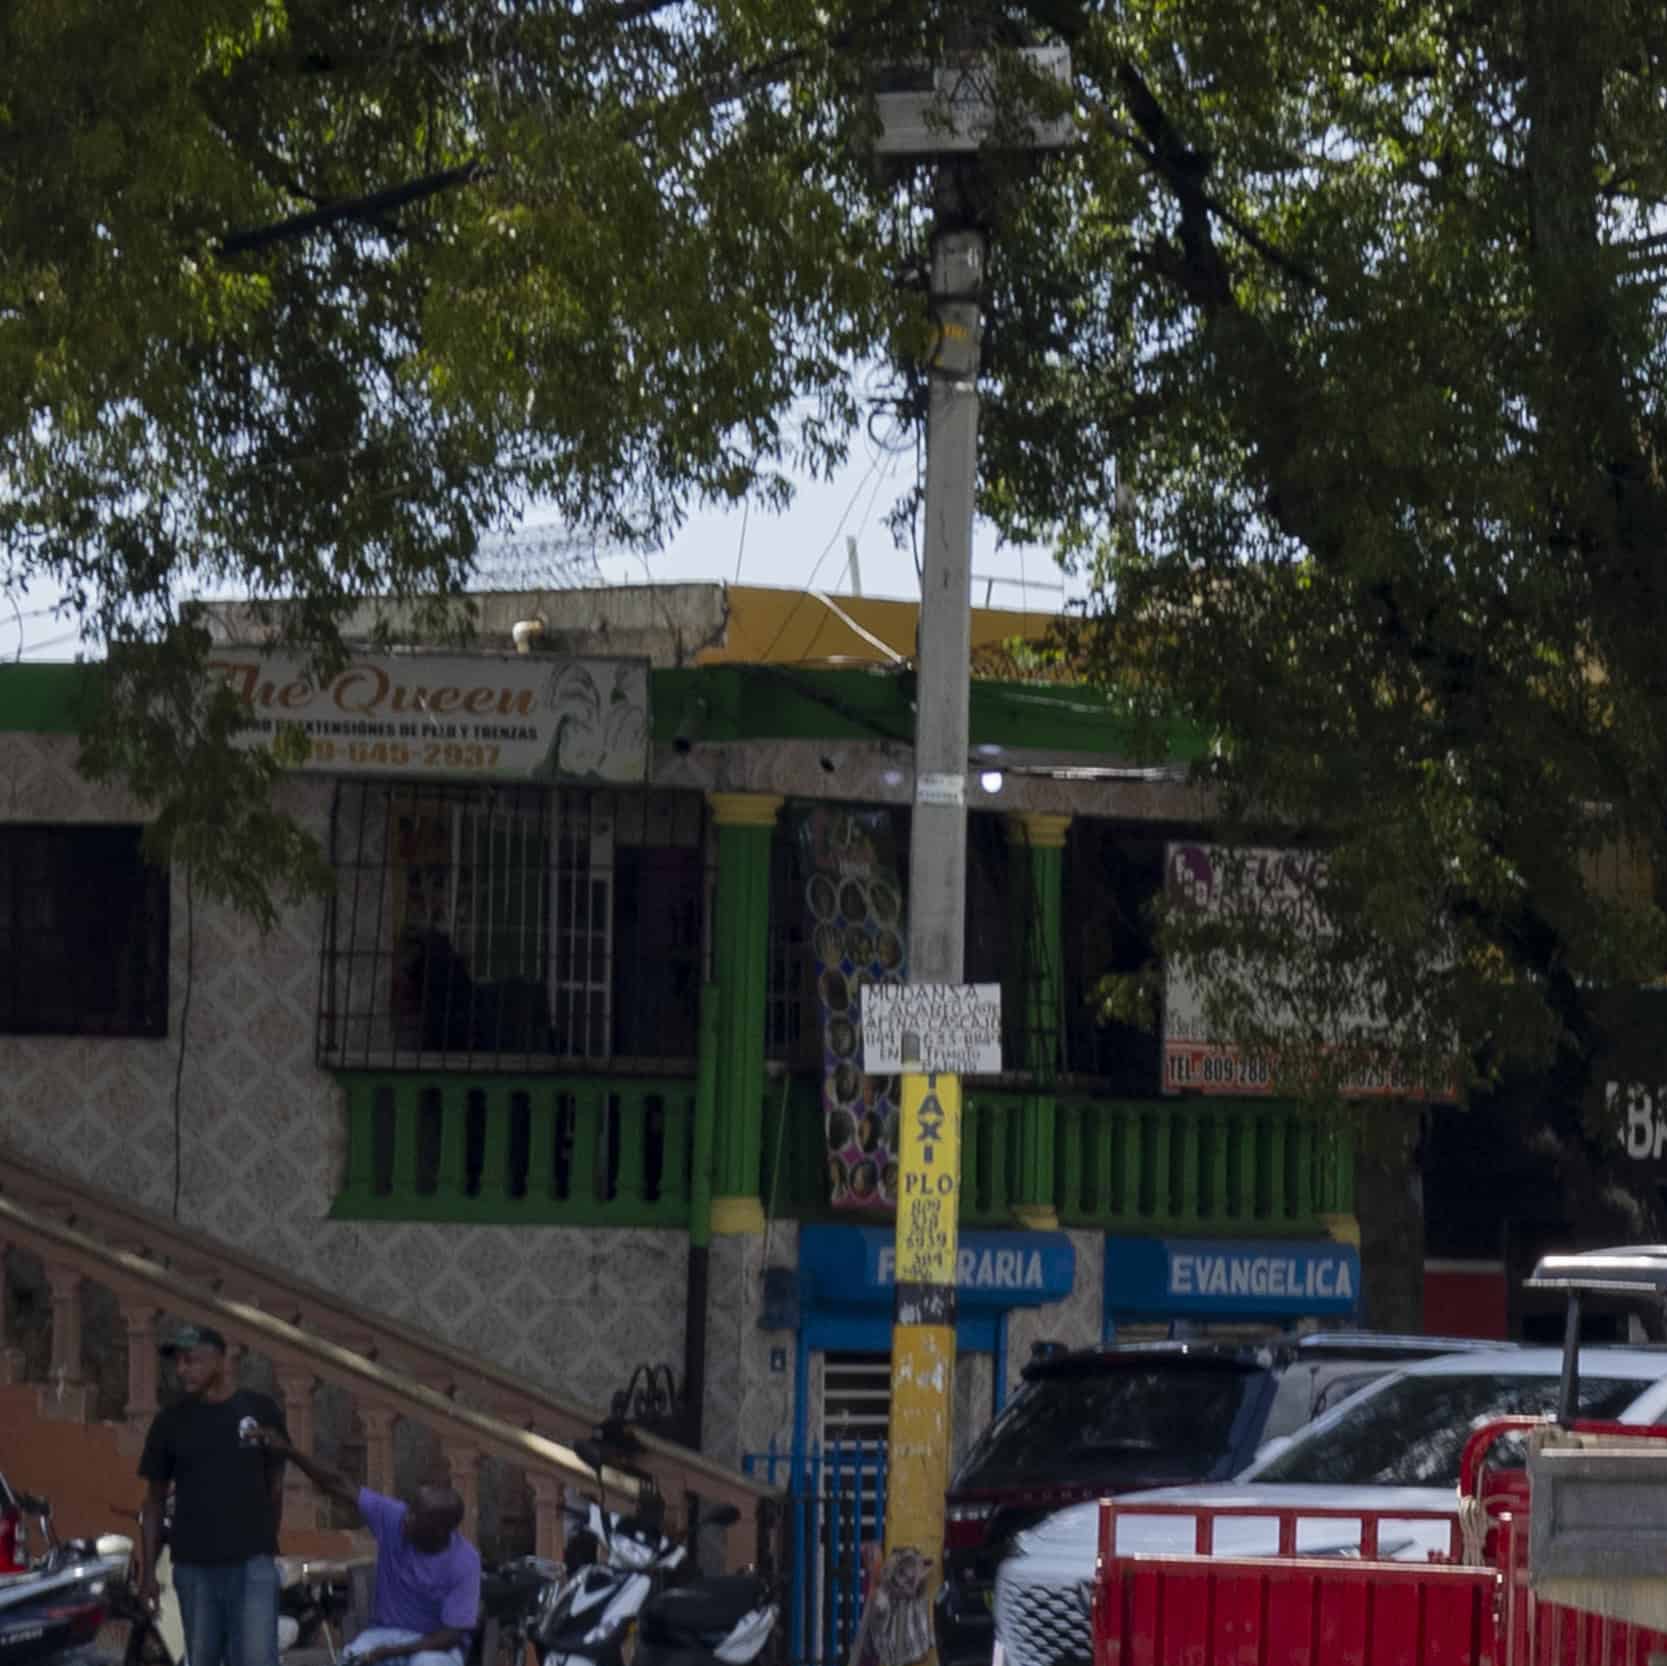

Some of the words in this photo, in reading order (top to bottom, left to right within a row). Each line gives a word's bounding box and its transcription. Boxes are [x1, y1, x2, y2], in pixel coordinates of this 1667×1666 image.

[331, 662, 538, 718] Queen
[904, 1172, 954, 1196] PLO
[1170, 1255, 1353, 1298] EVANGELICA
